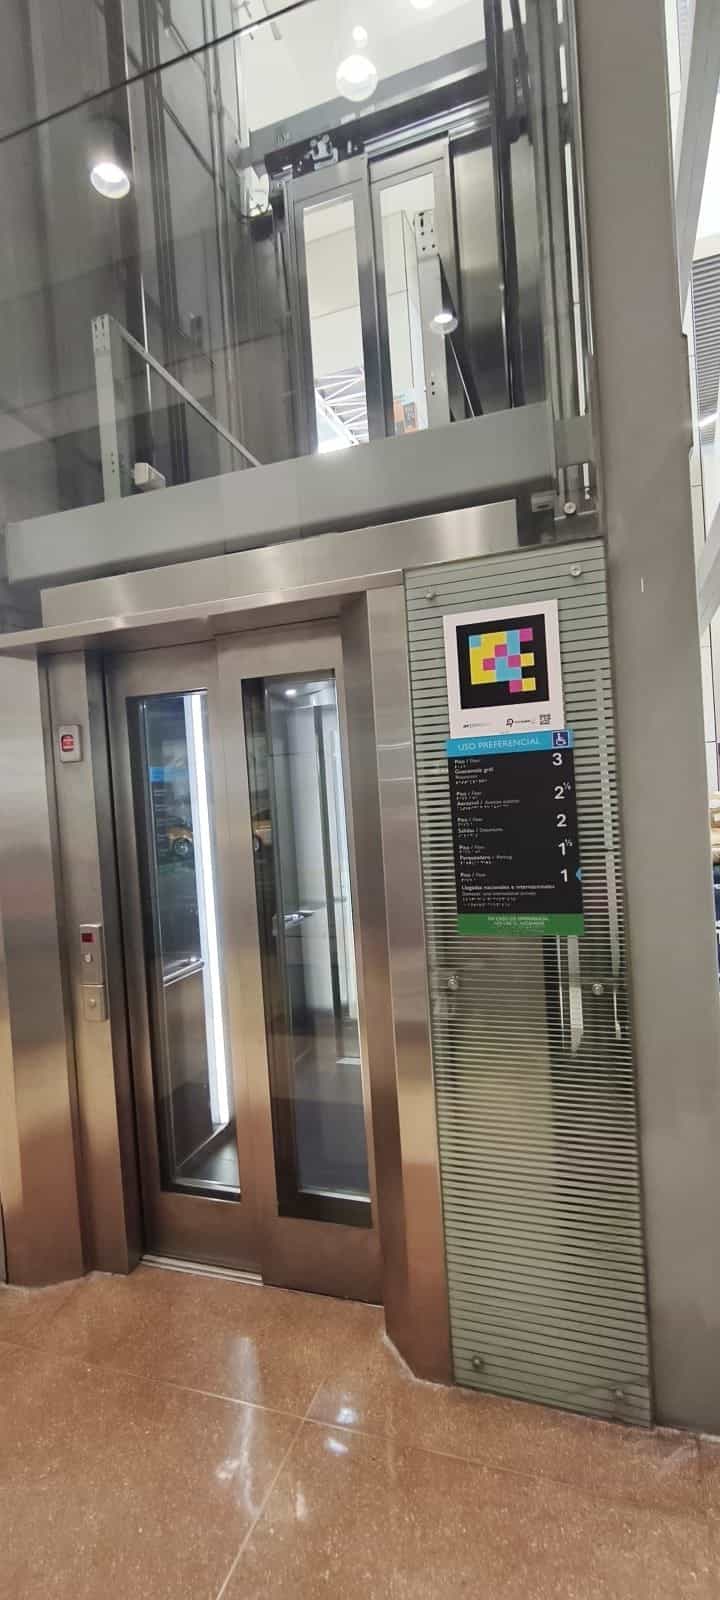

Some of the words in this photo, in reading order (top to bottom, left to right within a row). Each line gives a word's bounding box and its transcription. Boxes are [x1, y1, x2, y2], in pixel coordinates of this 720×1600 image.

[458, 743, 476, 751] USO
[479, 737, 540, 749] PREFERENCIAL
[552, 752, 563, 766] 3
[556, 813, 568, 828] 2
[560, 868, 568, 882] 1
